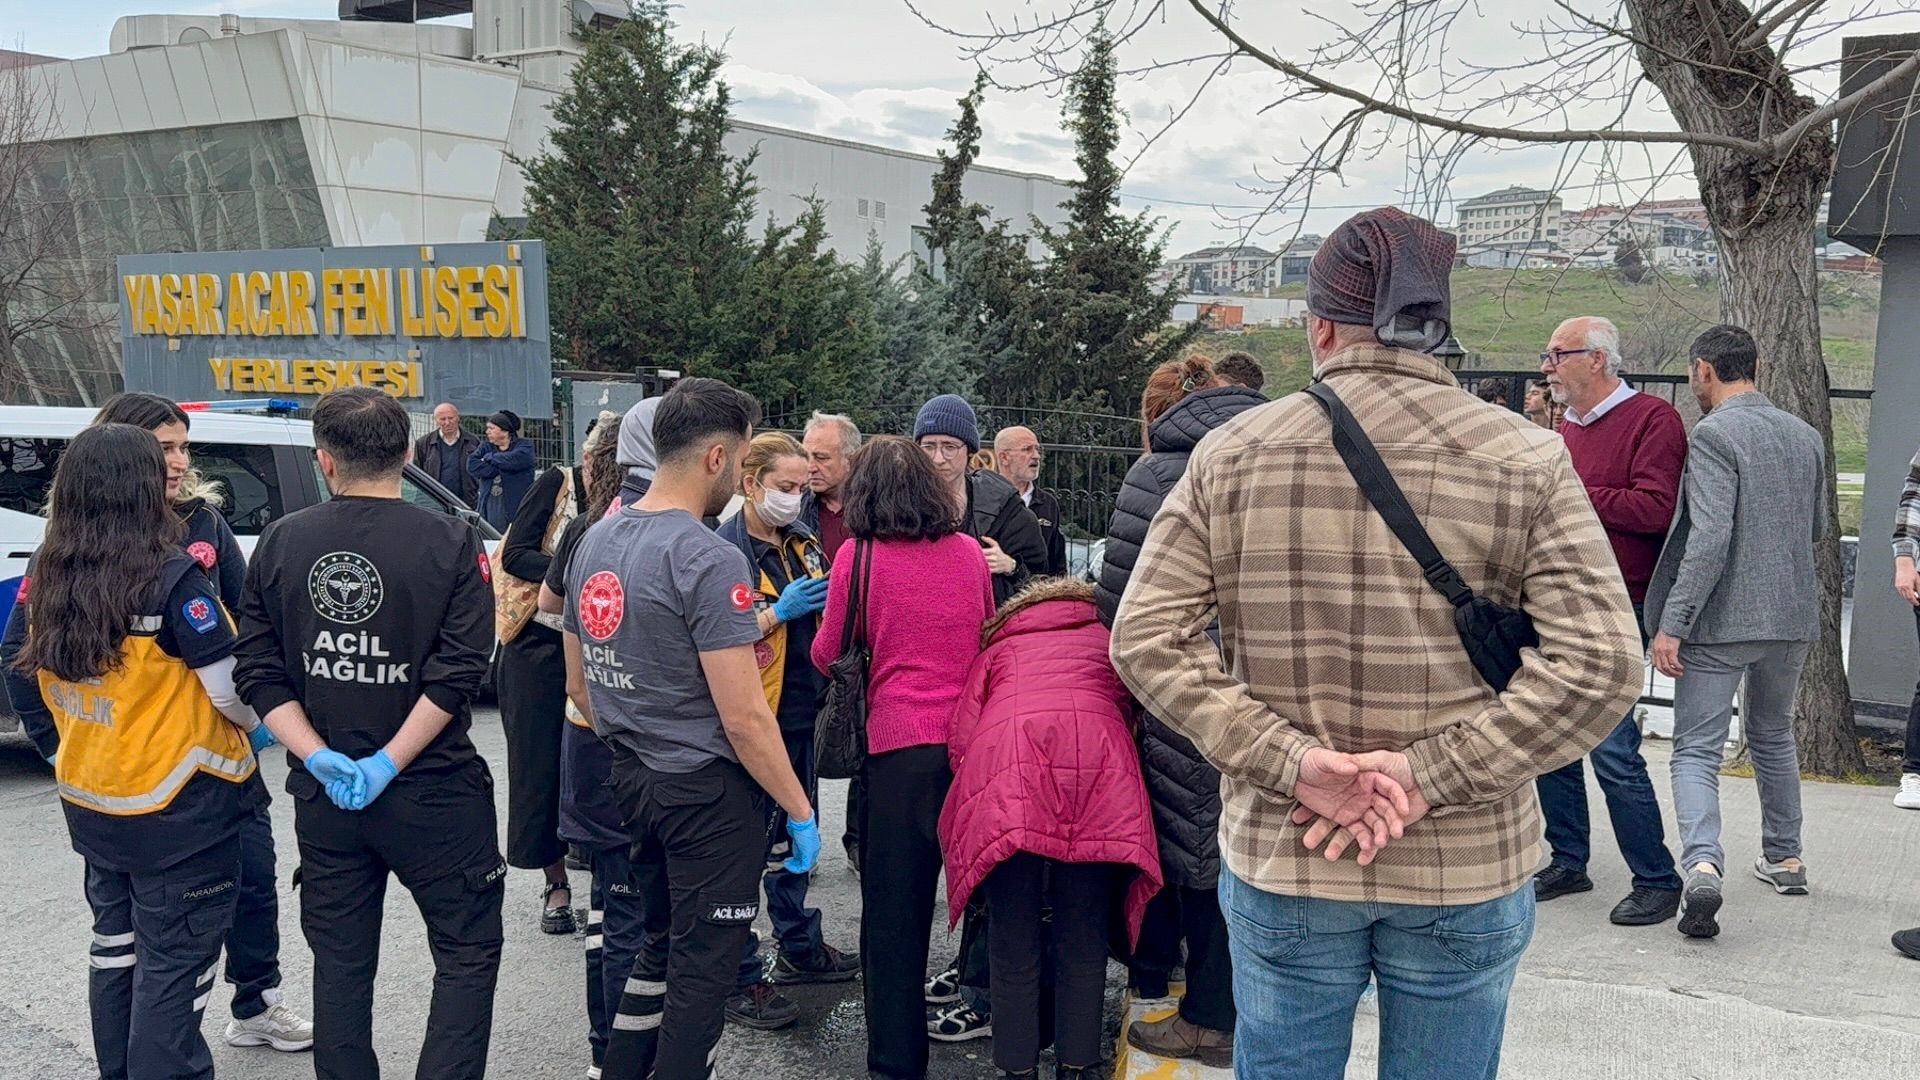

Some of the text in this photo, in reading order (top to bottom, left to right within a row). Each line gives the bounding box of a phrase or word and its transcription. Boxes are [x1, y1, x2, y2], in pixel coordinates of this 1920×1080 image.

[123, 244, 527, 351] YAŞAR ACAR FEN LİSESİ
[313, 630, 389, 656] ACİL
[584, 664, 636, 690] AĞLIK
[713, 905, 733, 919] ACİL
